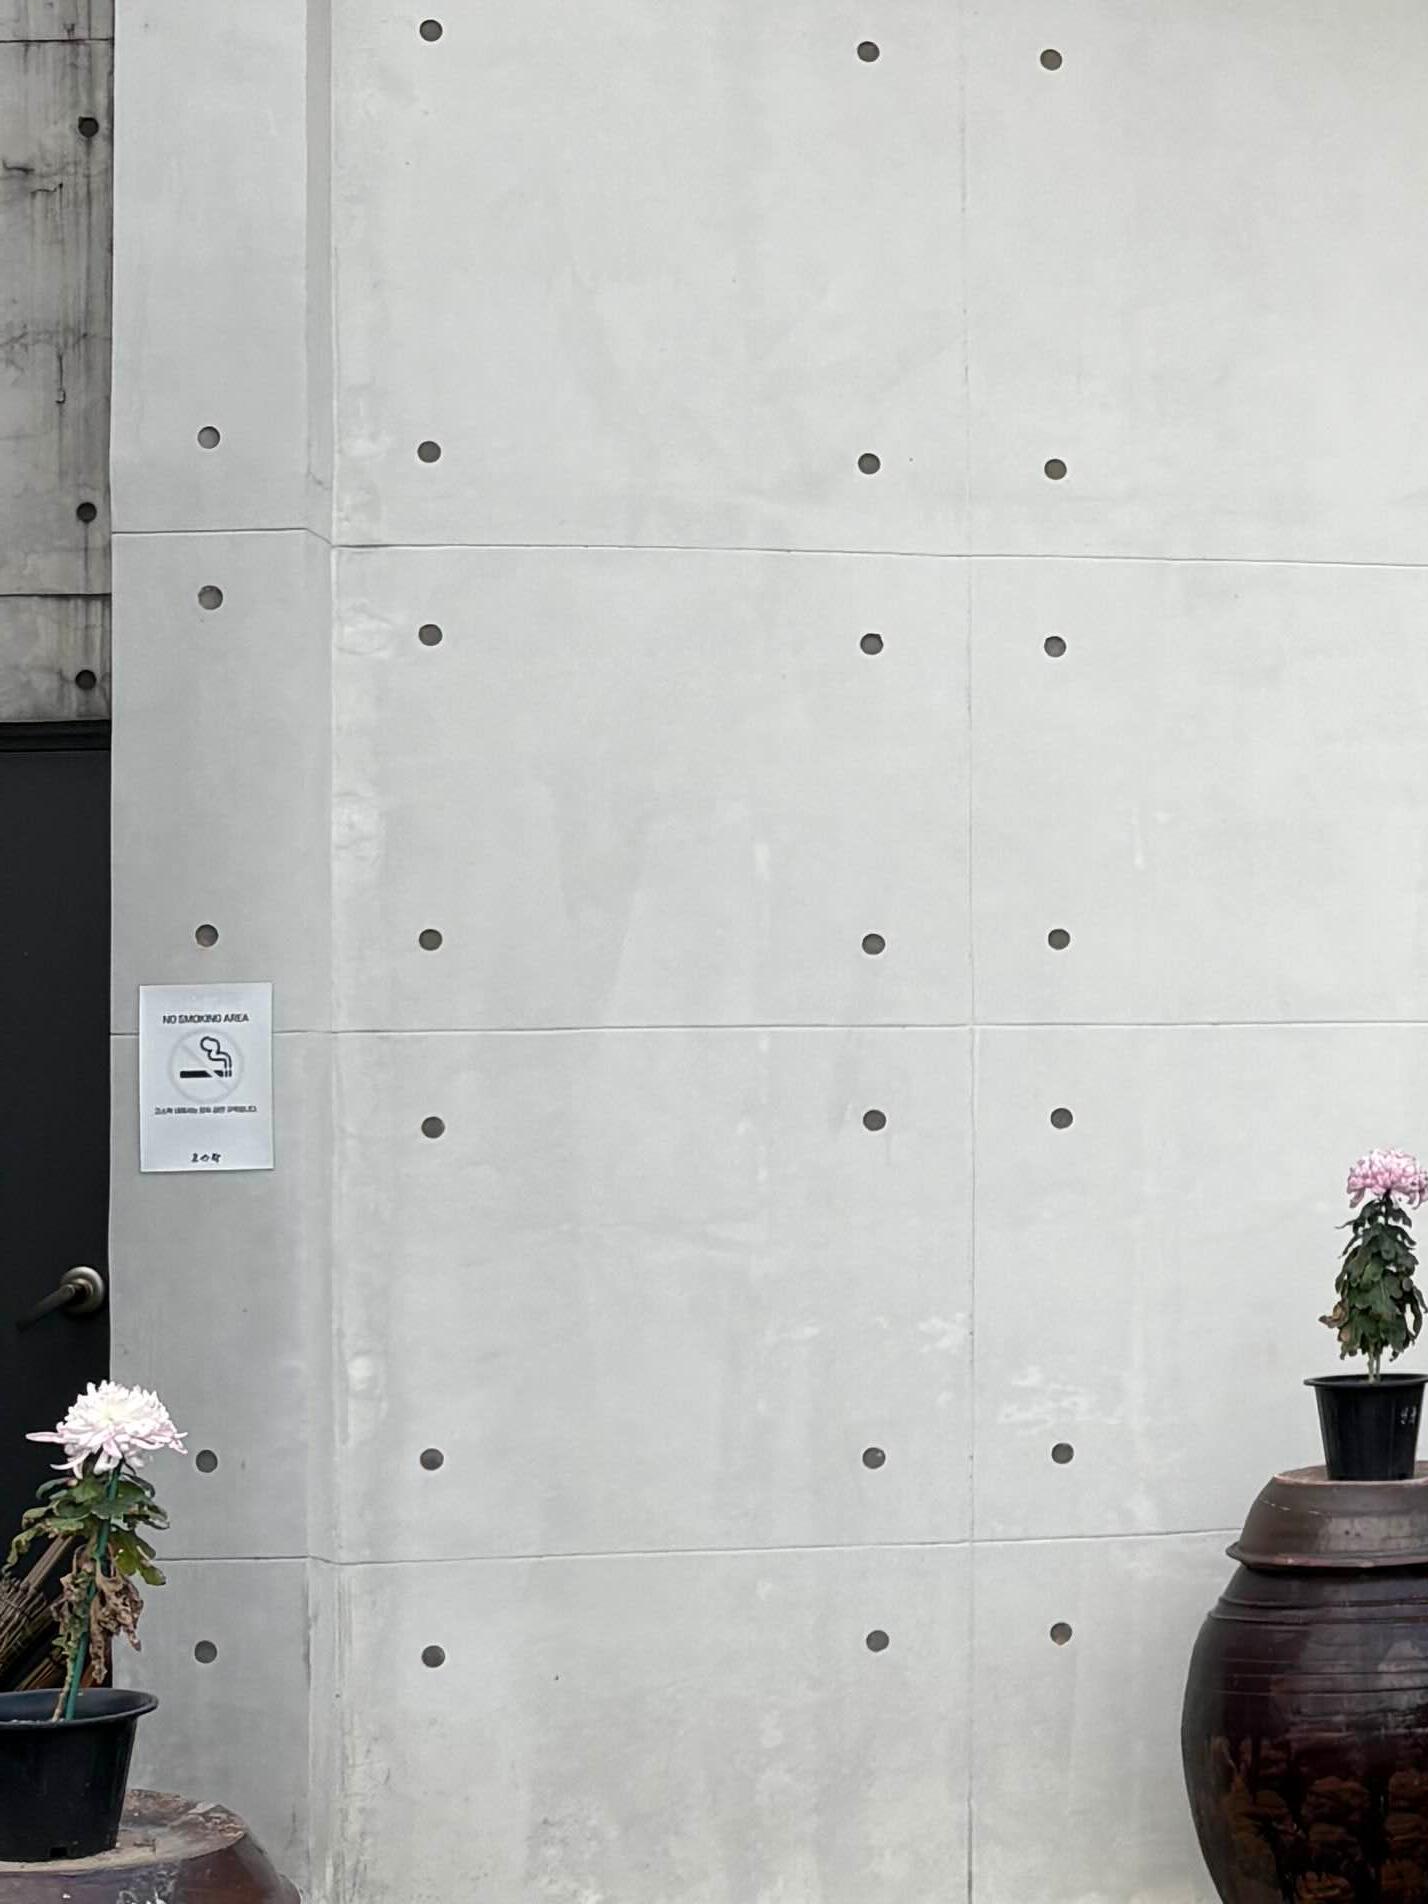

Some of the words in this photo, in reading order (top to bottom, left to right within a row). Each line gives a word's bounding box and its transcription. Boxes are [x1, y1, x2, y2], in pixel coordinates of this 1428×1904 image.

[162, 1014, 177, 1025] NO
[178, 1013, 222, 1024] SMOKING
[223, 1013, 250, 1023] AREA
